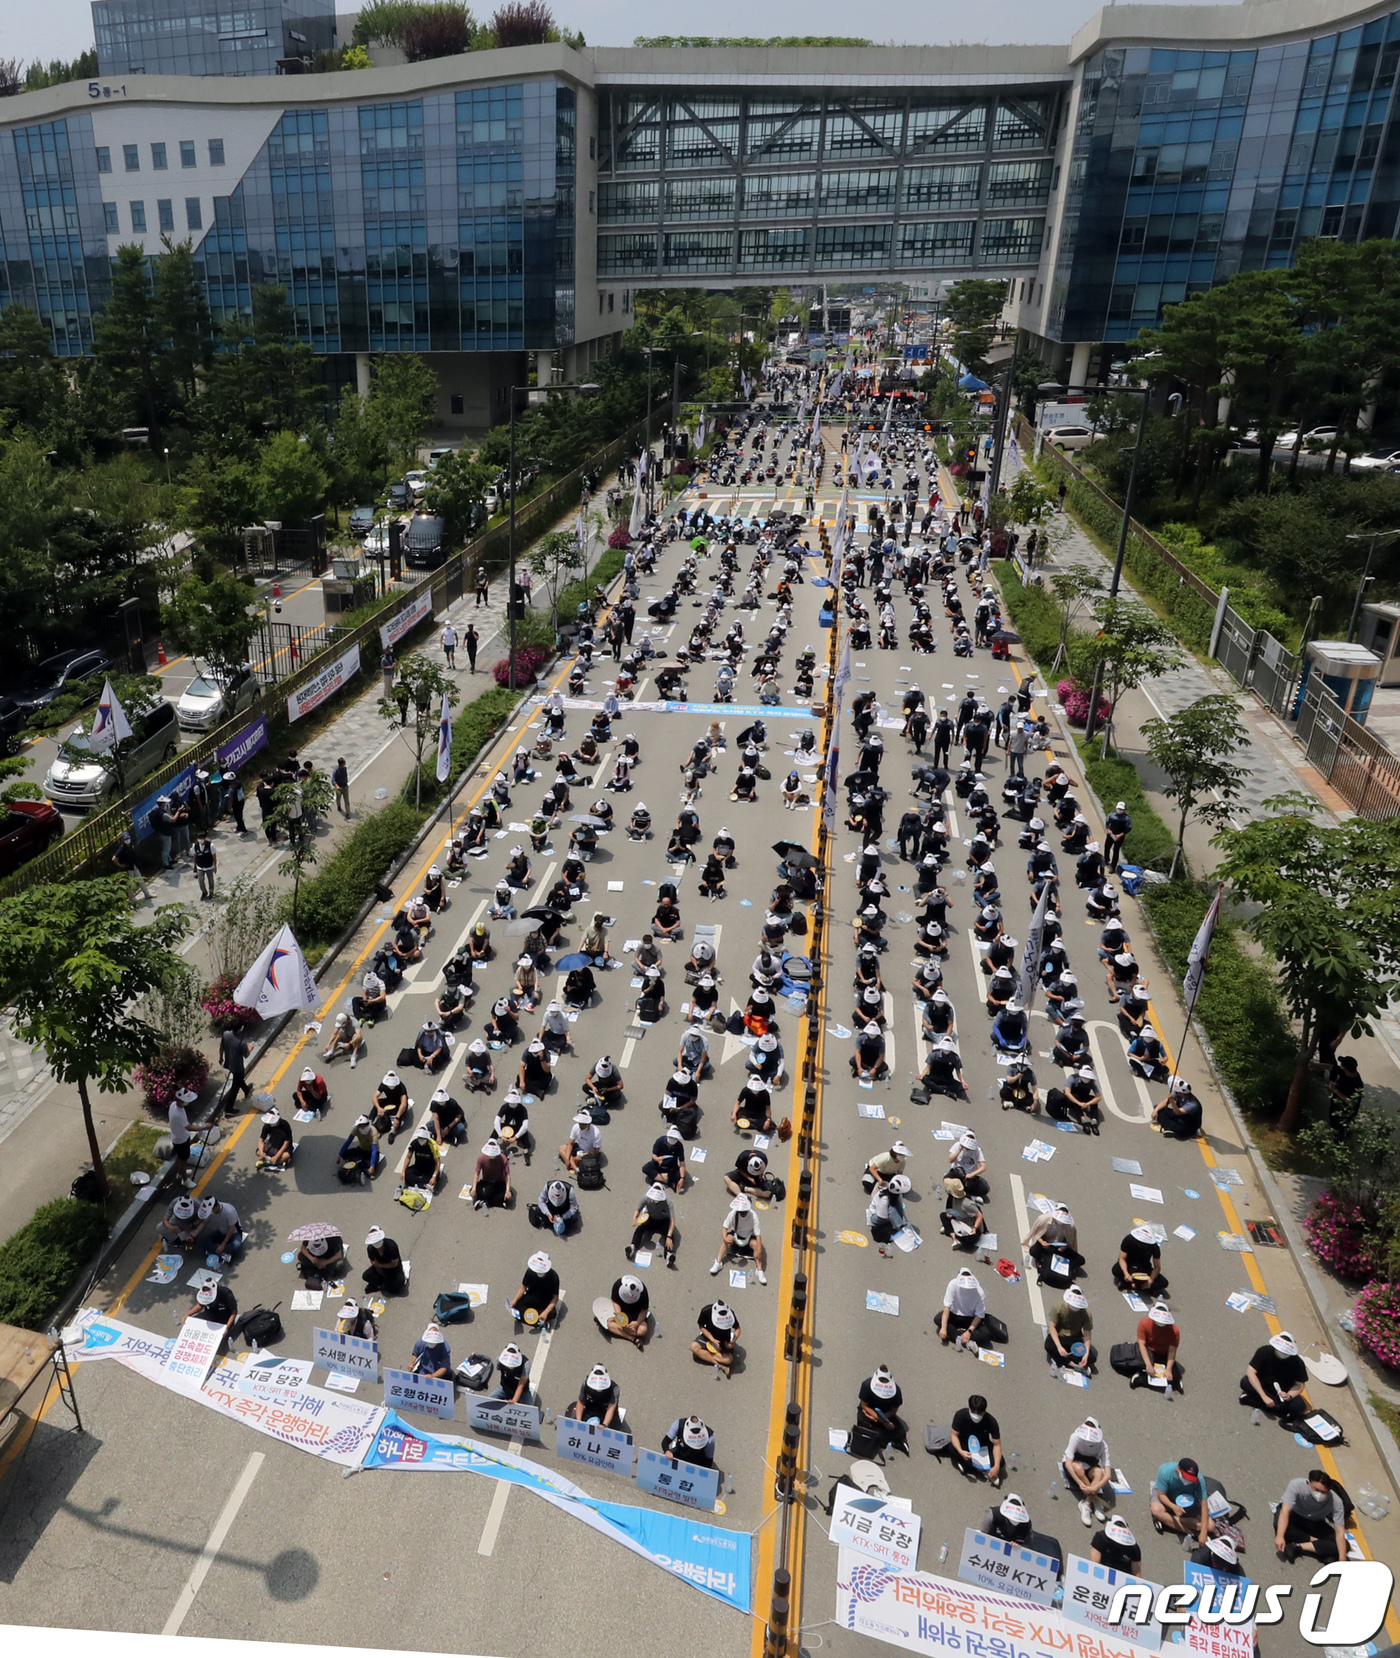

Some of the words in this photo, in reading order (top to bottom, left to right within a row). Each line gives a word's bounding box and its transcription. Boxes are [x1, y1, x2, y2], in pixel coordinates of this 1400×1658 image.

[184, 1328, 218, 1344] 허울뿐인
[178, 1339, 213, 1355] 고속철도
[174, 1350, 209, 1366] 경쟁체제
[318, 1346, 347, 1362] 수서행
[348, 1354, 373, 1369] KTX
[168, 1361, 204, 1378] 중단하라
[245, 1369, 273, 1384] 지금
[275, 1374, 303, 1388] 당장
[279, 1365, 304, 1374] KTX
[390, 1385, 448, 1407] 운행하라!
[236, 1398, 268, 1423] 즉각
[266, 1409, 331, 1444] 운행하라
[476, 1410, 532, 1430] 고속철도
[504, 1408, 531, 1417] SRT
[377, 1438, 425, 1461] 하나로
[573, 1452, 587, 1462] 10%
[839, 1510, 873, 1534] 지금
[878, 1525, 913, 1549] 당장
[879, 1512, 910, 1529] KTX
[892, 1551, 910, 1567] 통합
[967, 1554, 1010, 1577] 수서행
[1011, 1569, 1048, 1592] KTX
[978, 1574, 995, 1586] 10%
[997, 1581, 1032, 1600] 요금인하
[892, 1578, 978, 1625] 운행하라
[917, 1614, 962, 1647] 위해
[981, 1605, 1026, 1641] 즉각
[1121, 1624, 1139, 1640] 발전
[1028, 1621, 1074, 1653] KTX
[1190, 1634, 1209, 1654] 즉각
[1223, 1627, 1251, 1648] KTX
